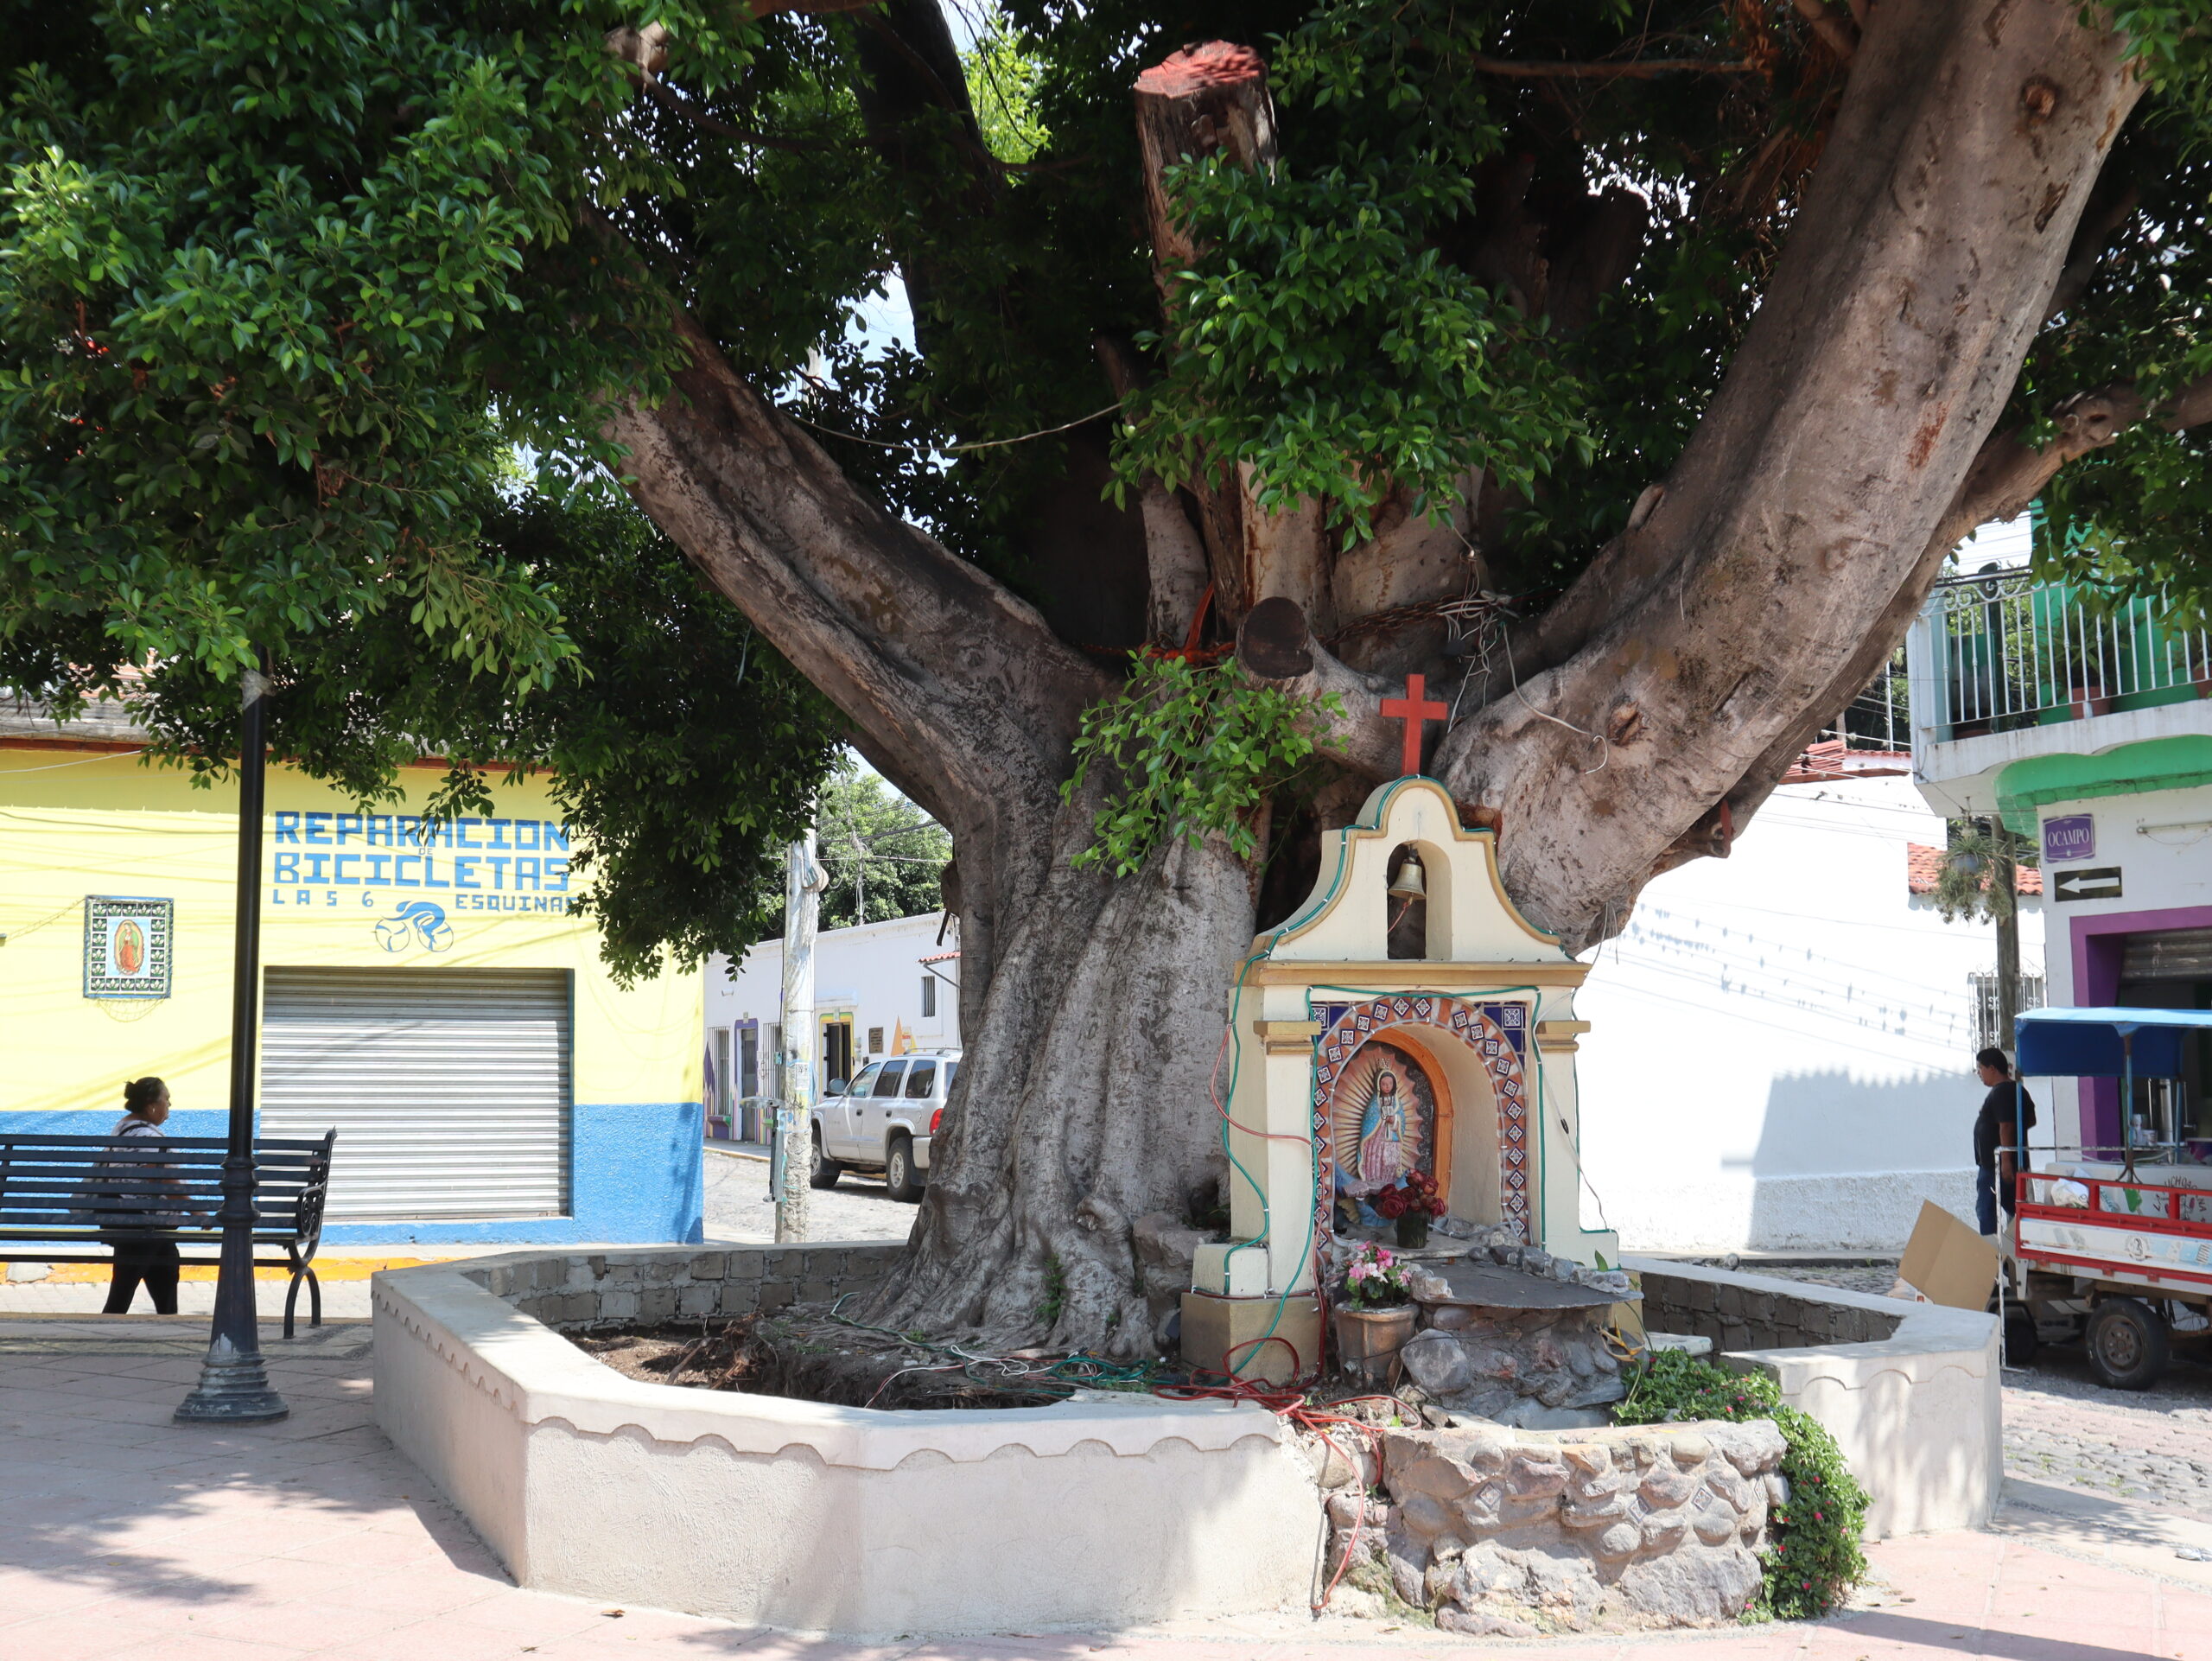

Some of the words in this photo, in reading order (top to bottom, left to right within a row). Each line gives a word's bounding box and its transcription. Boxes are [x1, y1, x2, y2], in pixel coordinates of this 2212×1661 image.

[275, 811, 569, 852] REPARACION
[2048, 828, 2089, 847] OCAMPO
[274, 852, 569, 892] BICICLETAS
[272, 889, 338, 907] LAS
[361, 891, 374, 907] 6
